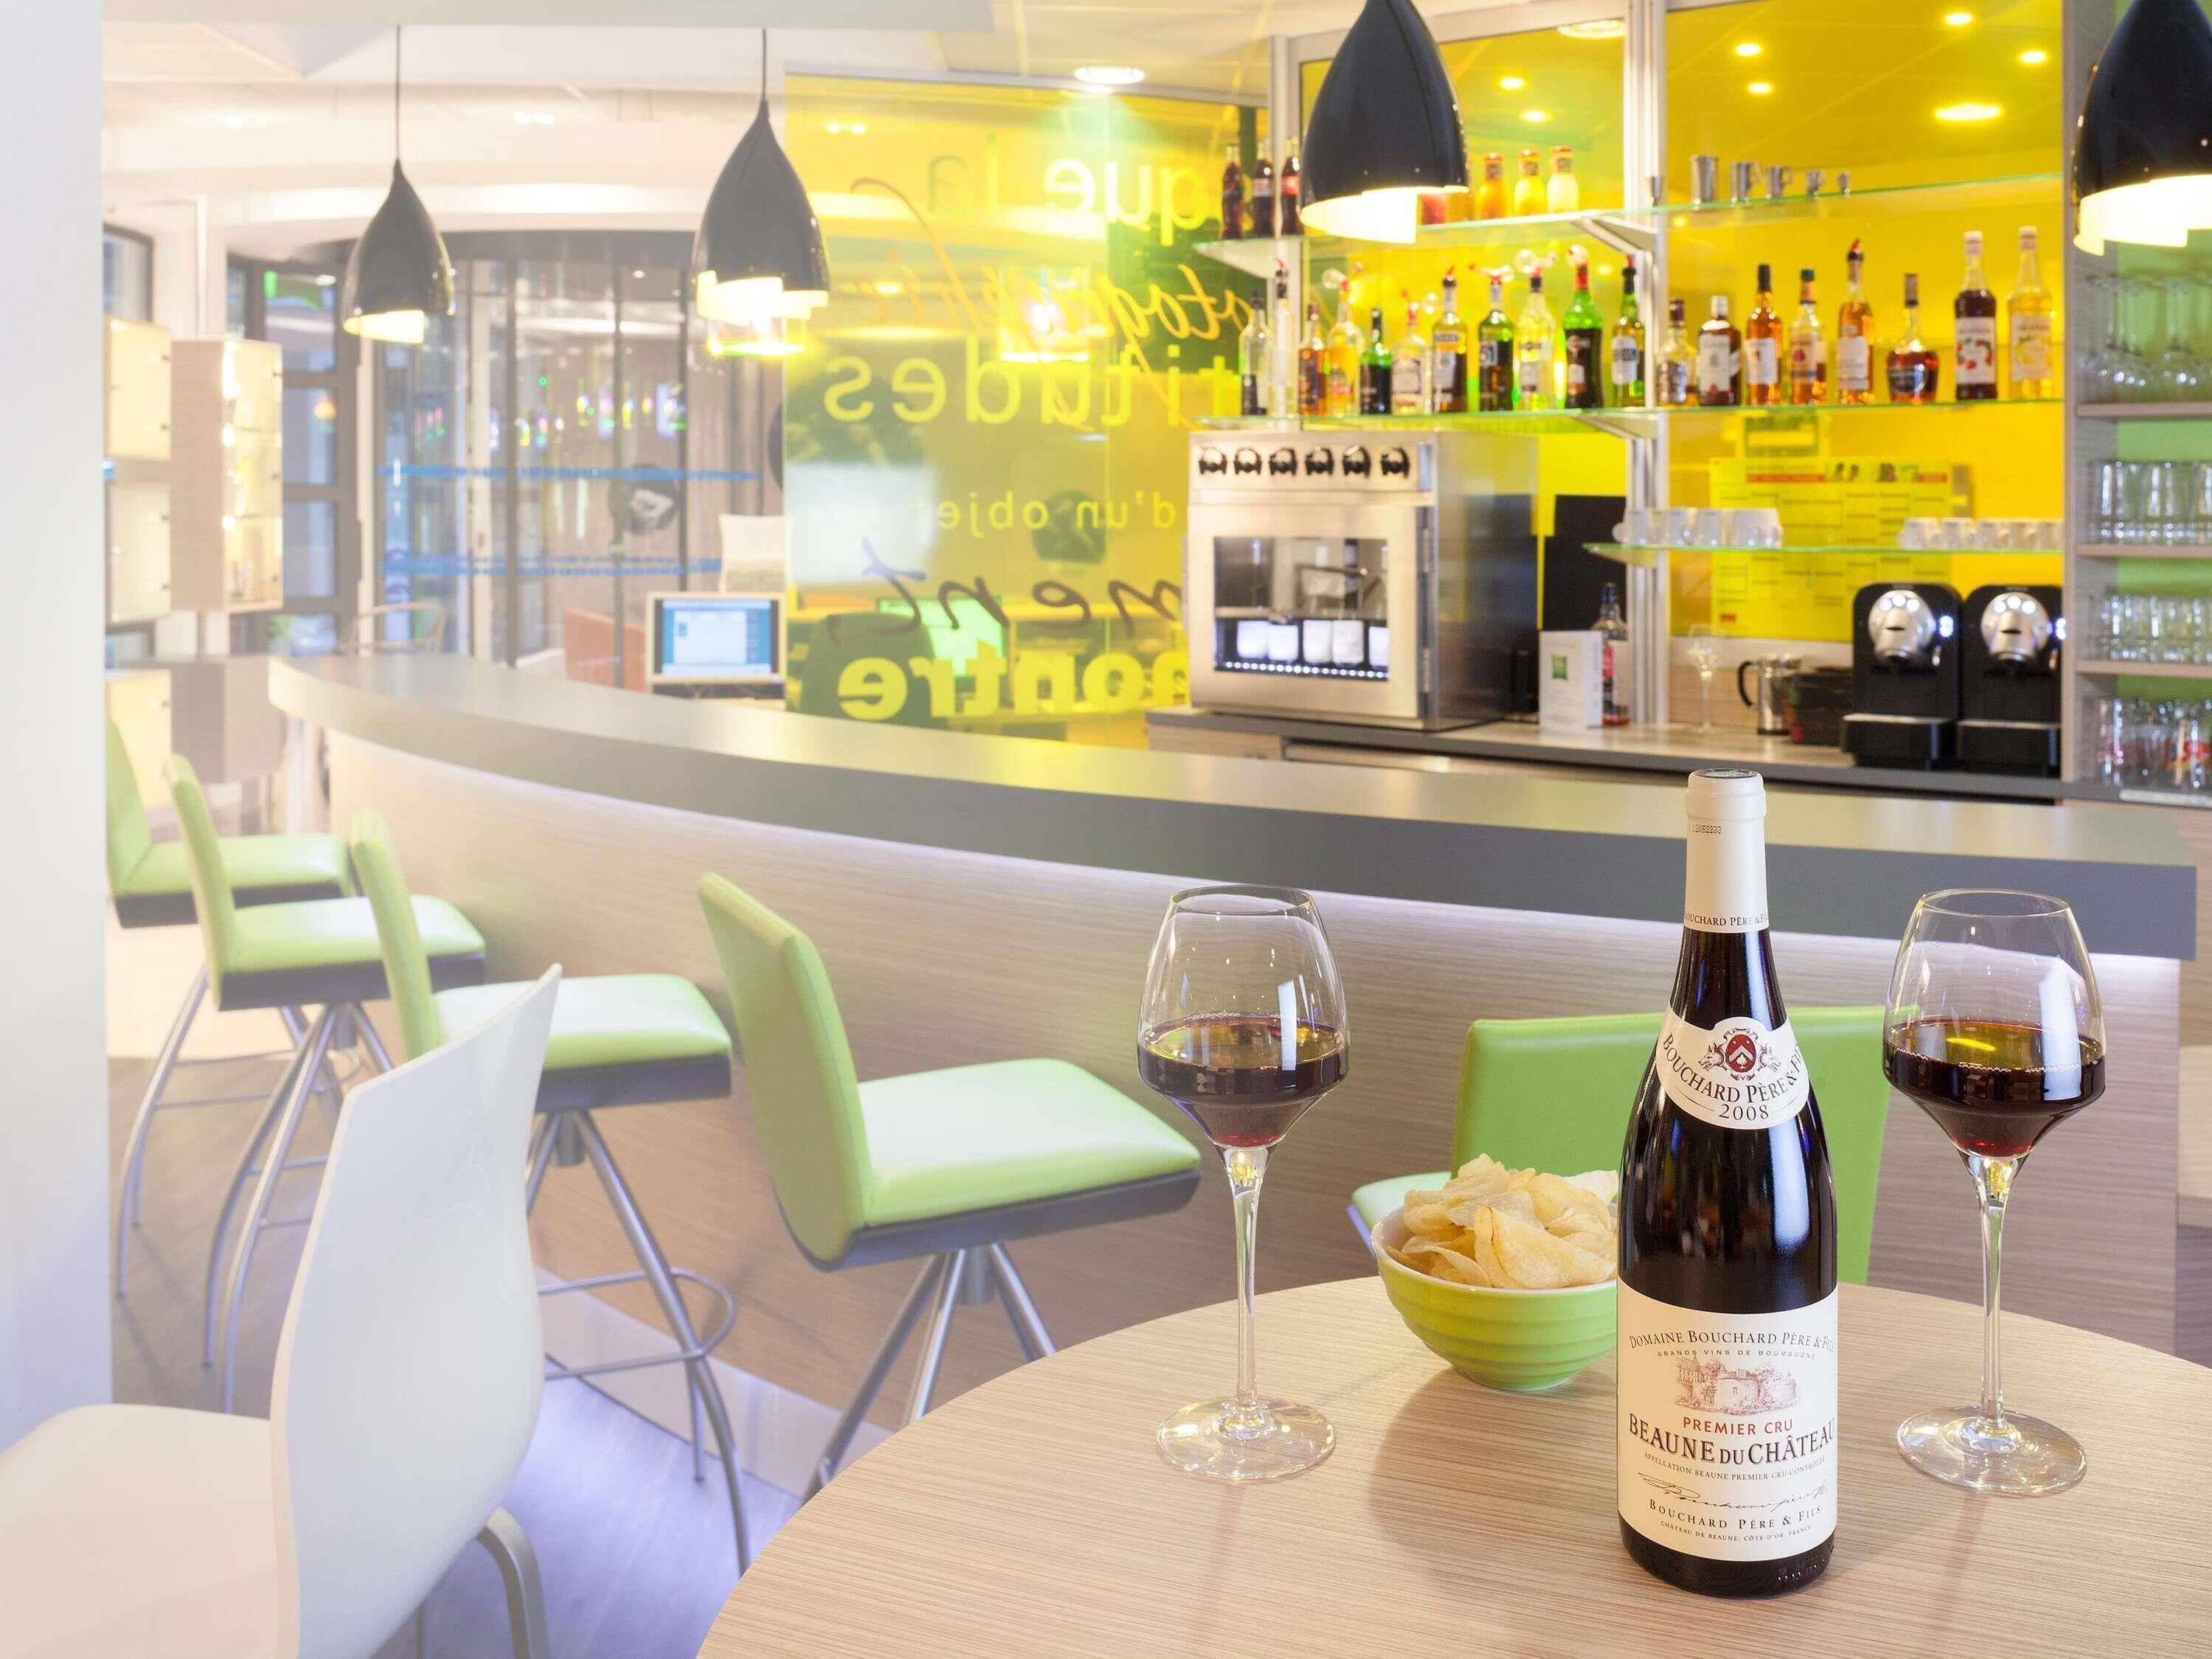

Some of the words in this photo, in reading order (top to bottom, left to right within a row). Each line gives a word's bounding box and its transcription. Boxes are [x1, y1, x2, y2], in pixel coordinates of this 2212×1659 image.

[1730, 916, 1753, 926] PÈRE
[1663, 1032, 1740, 1103] BOUCHARD
[1745, 1081, 1788, 1104] PÈRE
[1786, 1071, 1797, 1085] &
[1719, 1104, 1769, 1121] 2008
[1629, 1332, 1684, 1349] DOMAINE
[1687, 1329, 1777, 1343] BOUCHARD
[1782, 1331, 1812, 1346] PÈRE
[1813, 1335, 1821, 1348] &
[1657, 1349, 1697, 1357] GRANDS
[1759, 1349, 1815, 1360] BOURGOGNE
[1683, 1416, 1756, 1436] PREMIER
[1764, 1419, 1792, 1434] CRU
[1630, 1413, 1715, 1462] BEAUNE
[1719, 1448, 1745, 1465] DU
[1747, 1416, 1834, 1464] CHÂTEAU
[1644, 1452, 1692, 1474] APPELLATION
[1694, 1469, 1729, 1481] BEAUNE
[1771, 1470, 1787, 1479] CRU
[1649, 1498, 1727, 1528] BOUCHARD
[1739, 1518, 1775, 1529] PÈRE
[1782, 1515, 1792, 1526] &
[1798, 1506, 1821, 1522] FILS
[1660, 1520, 1692, 1535] CHÂTEAU
[1789, 1525, 1811, 1536] FRANCE
